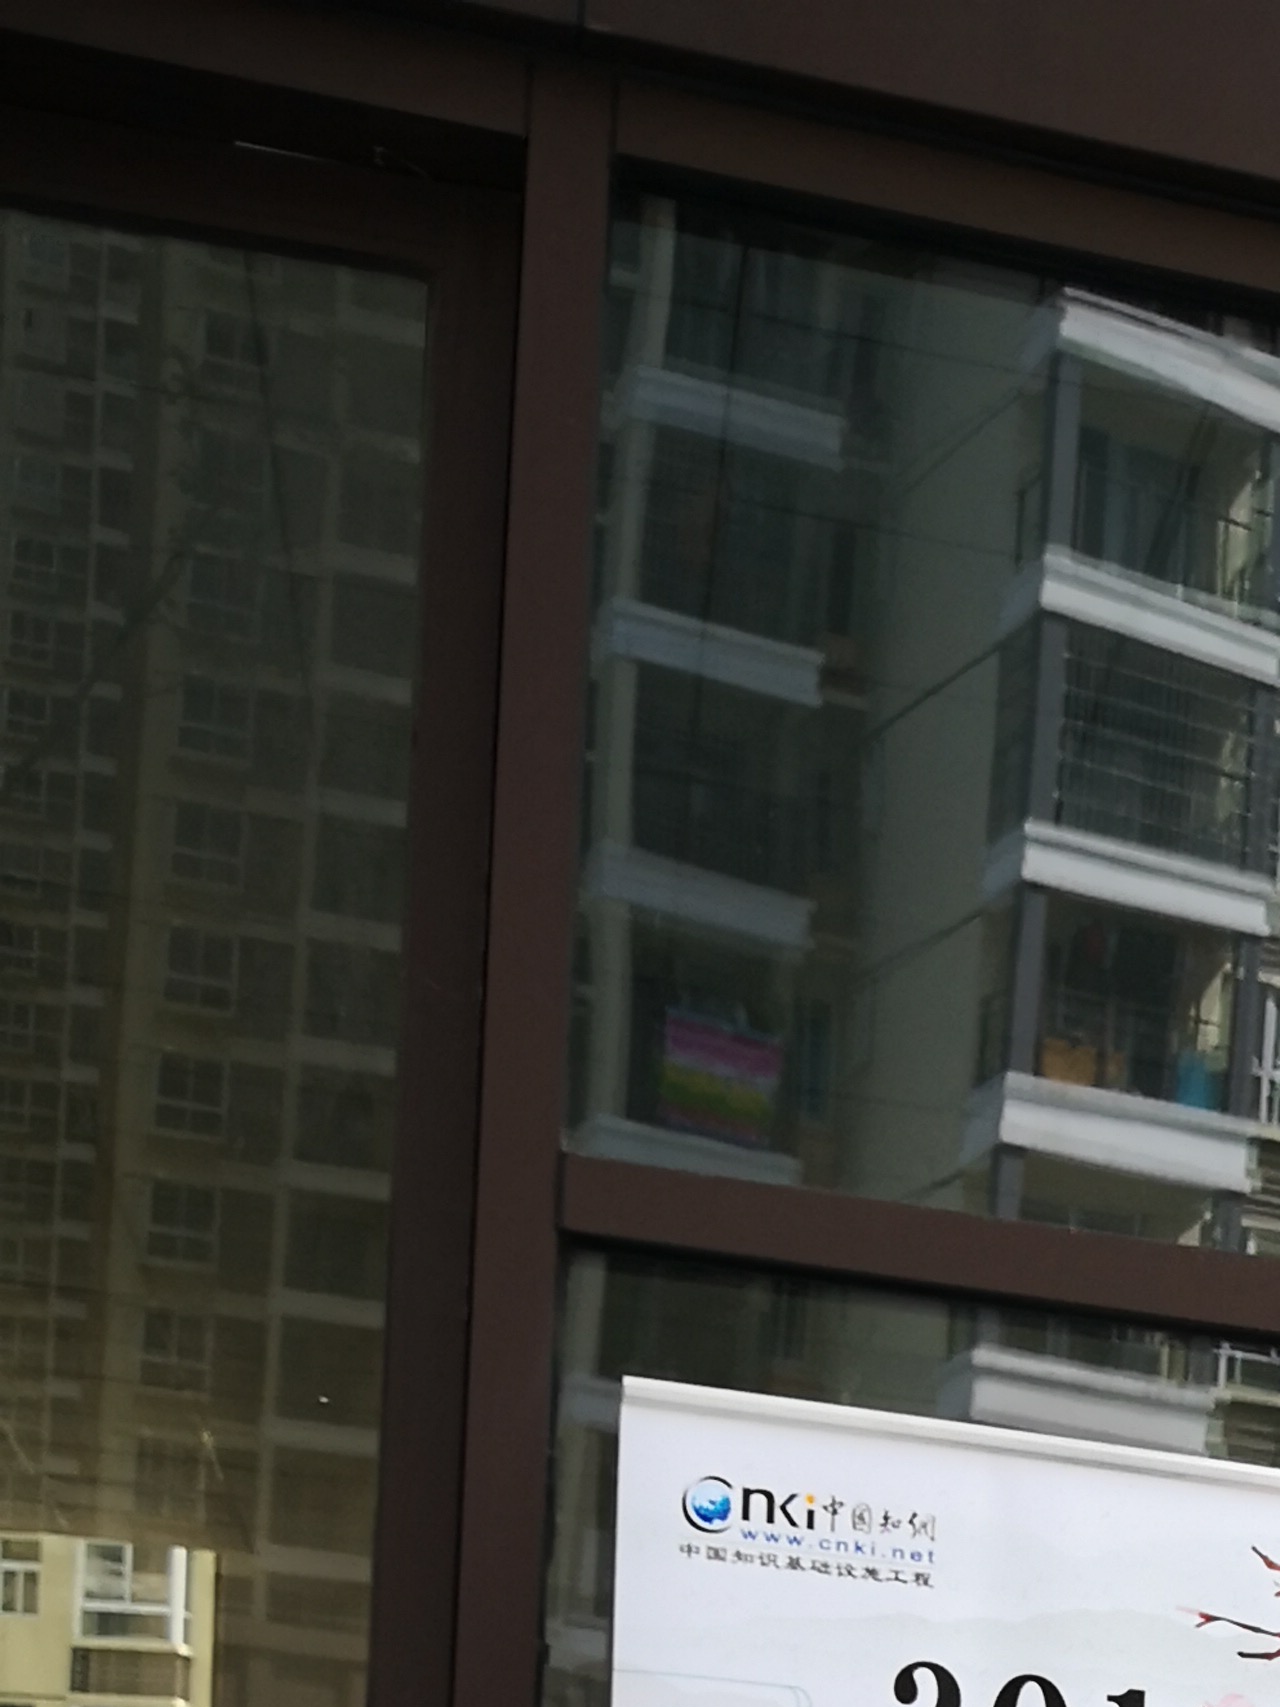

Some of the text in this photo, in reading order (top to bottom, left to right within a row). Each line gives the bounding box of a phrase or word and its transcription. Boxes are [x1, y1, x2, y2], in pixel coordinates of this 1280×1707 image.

[680, 1542, 934, 1588] 中国知识基础设施工程
[741, 1529, 935, 1563] www.cnki.net
